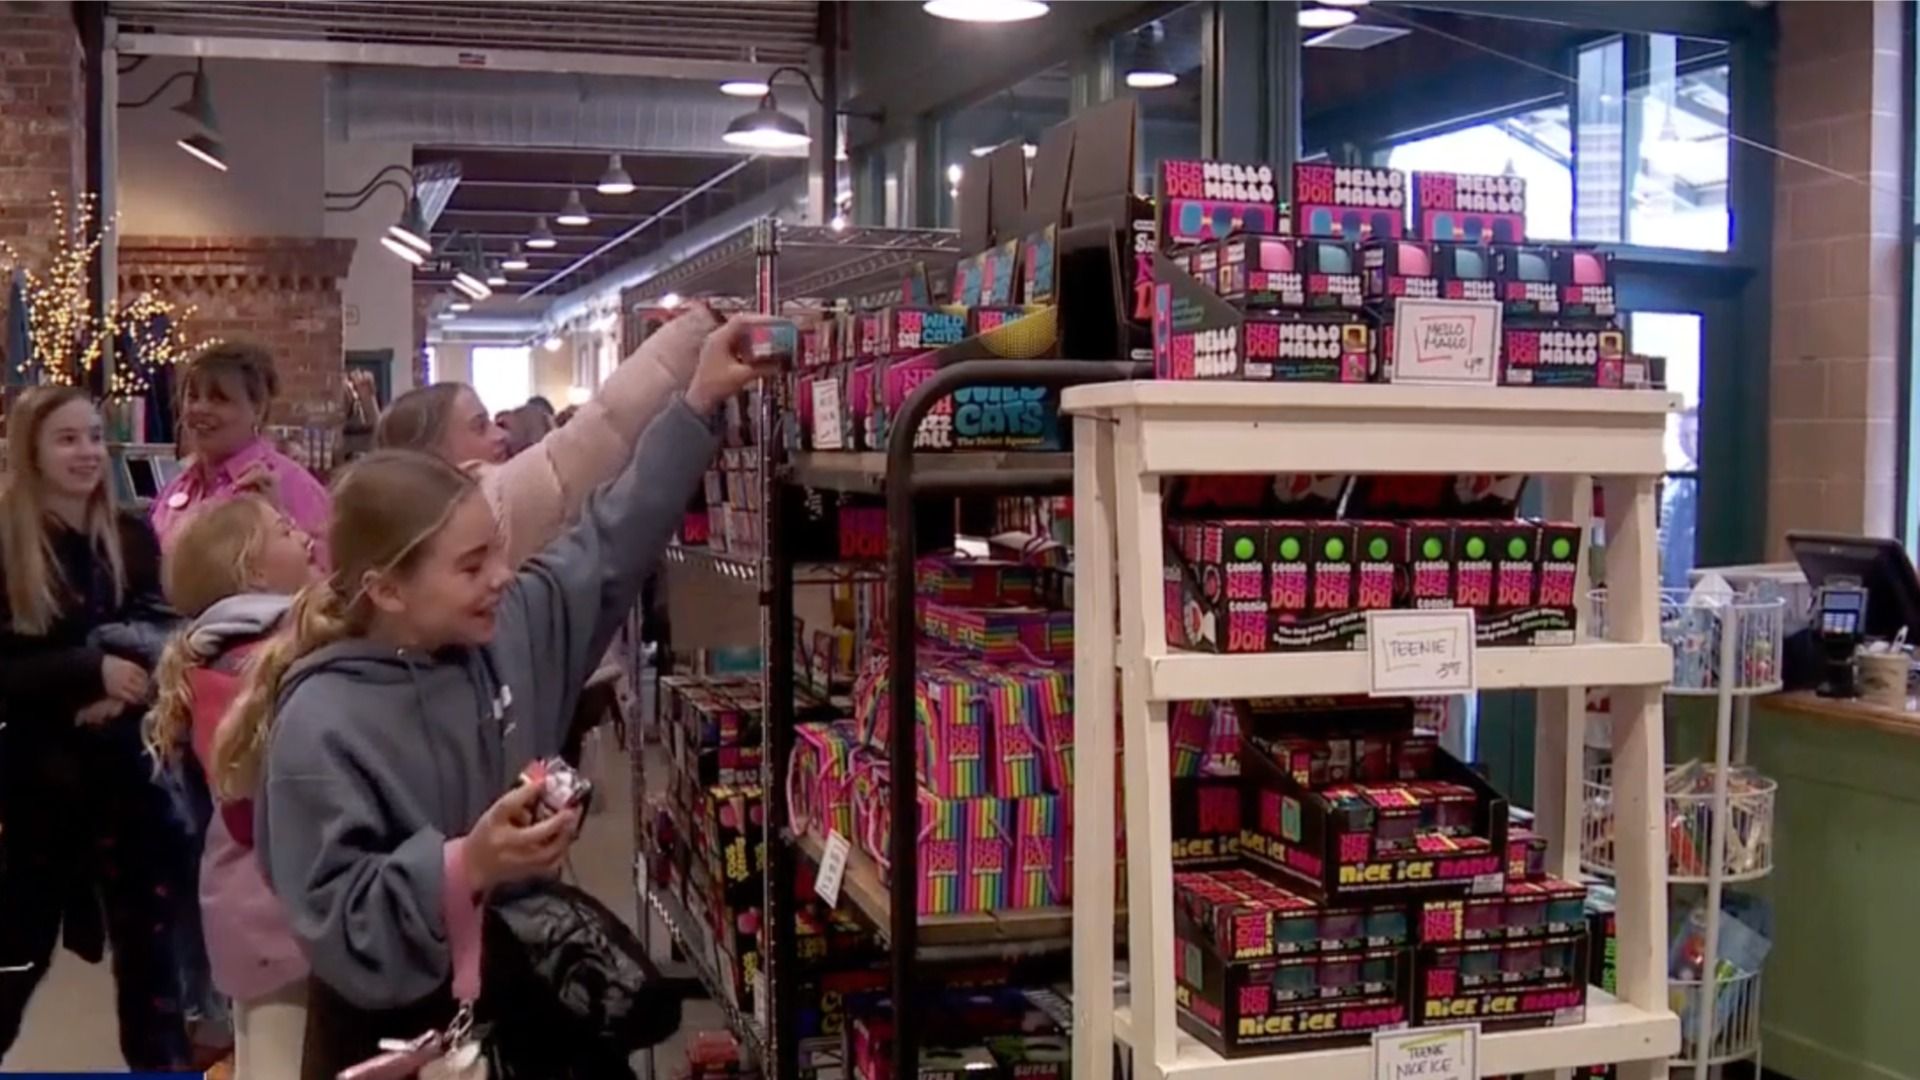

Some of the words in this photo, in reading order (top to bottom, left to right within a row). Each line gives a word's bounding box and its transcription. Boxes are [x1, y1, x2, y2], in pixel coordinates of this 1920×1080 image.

[1203, 162, 1272, 183] MELLO
[1335, 167, 1401, 188] MELLO
[1167, 177, 1203, 198] DOH
[1204, 181, 1274, 202] MALLO
[1298, 181, 1333, 204] DOH
[1456, 174, 1522, 193] MELLO
[1335, 186, 1402, 207] MALLO
[1420, 187, 1455, 209] DOH
[1456, 192, 1523, 212] MALLO
[922, 312, 964, 326] WILD
[922, 328, 964, 342] CATS
[1194, 325, 1237, 354] MELLO
[1280, 324, 1340, 342] MELLO
[1539, 331, 1597, 348] MELLO
[1247, 338, 1280, 358] DOH
[1280, 340, 1340, 358] MALLO
[1539, 347, 1597, 365] MALLO
[1194, 350, 1237, 377] MALLO
[954, 402, 1043, 437] CATS
[1226, 571, 1263, 591] NEE
[1271, 571, 1307, 591] NEE
[1315, 571, 1350, 593] NEE
[1360, 570, 1394, 593] NEE
[1414, 570, 1449, 593] NEE
[1458, 569, 1492, 589] NEE
[1499, 569, 1532, 590] NEE
[1541, 570, 1575, 590] NEE
[1270, 587, 1306, 609] DOH
[1314, 587, 1349, 609] DOH
[1358, 587, 1392, 608] DOH
[1456, 585, 1491, 606] DOH
[1498, 585, 1531, 606] DOH
[1539, 585, 1572, 606] DOH
[1229, 610, 1268, 631] NEE
[1228, 628, 1267, 651] DOH
[1388, 638, 1448, 658] TEENIE
[950, 738, 979, 756] DOH
[930, 852, 958, 871] DOH
